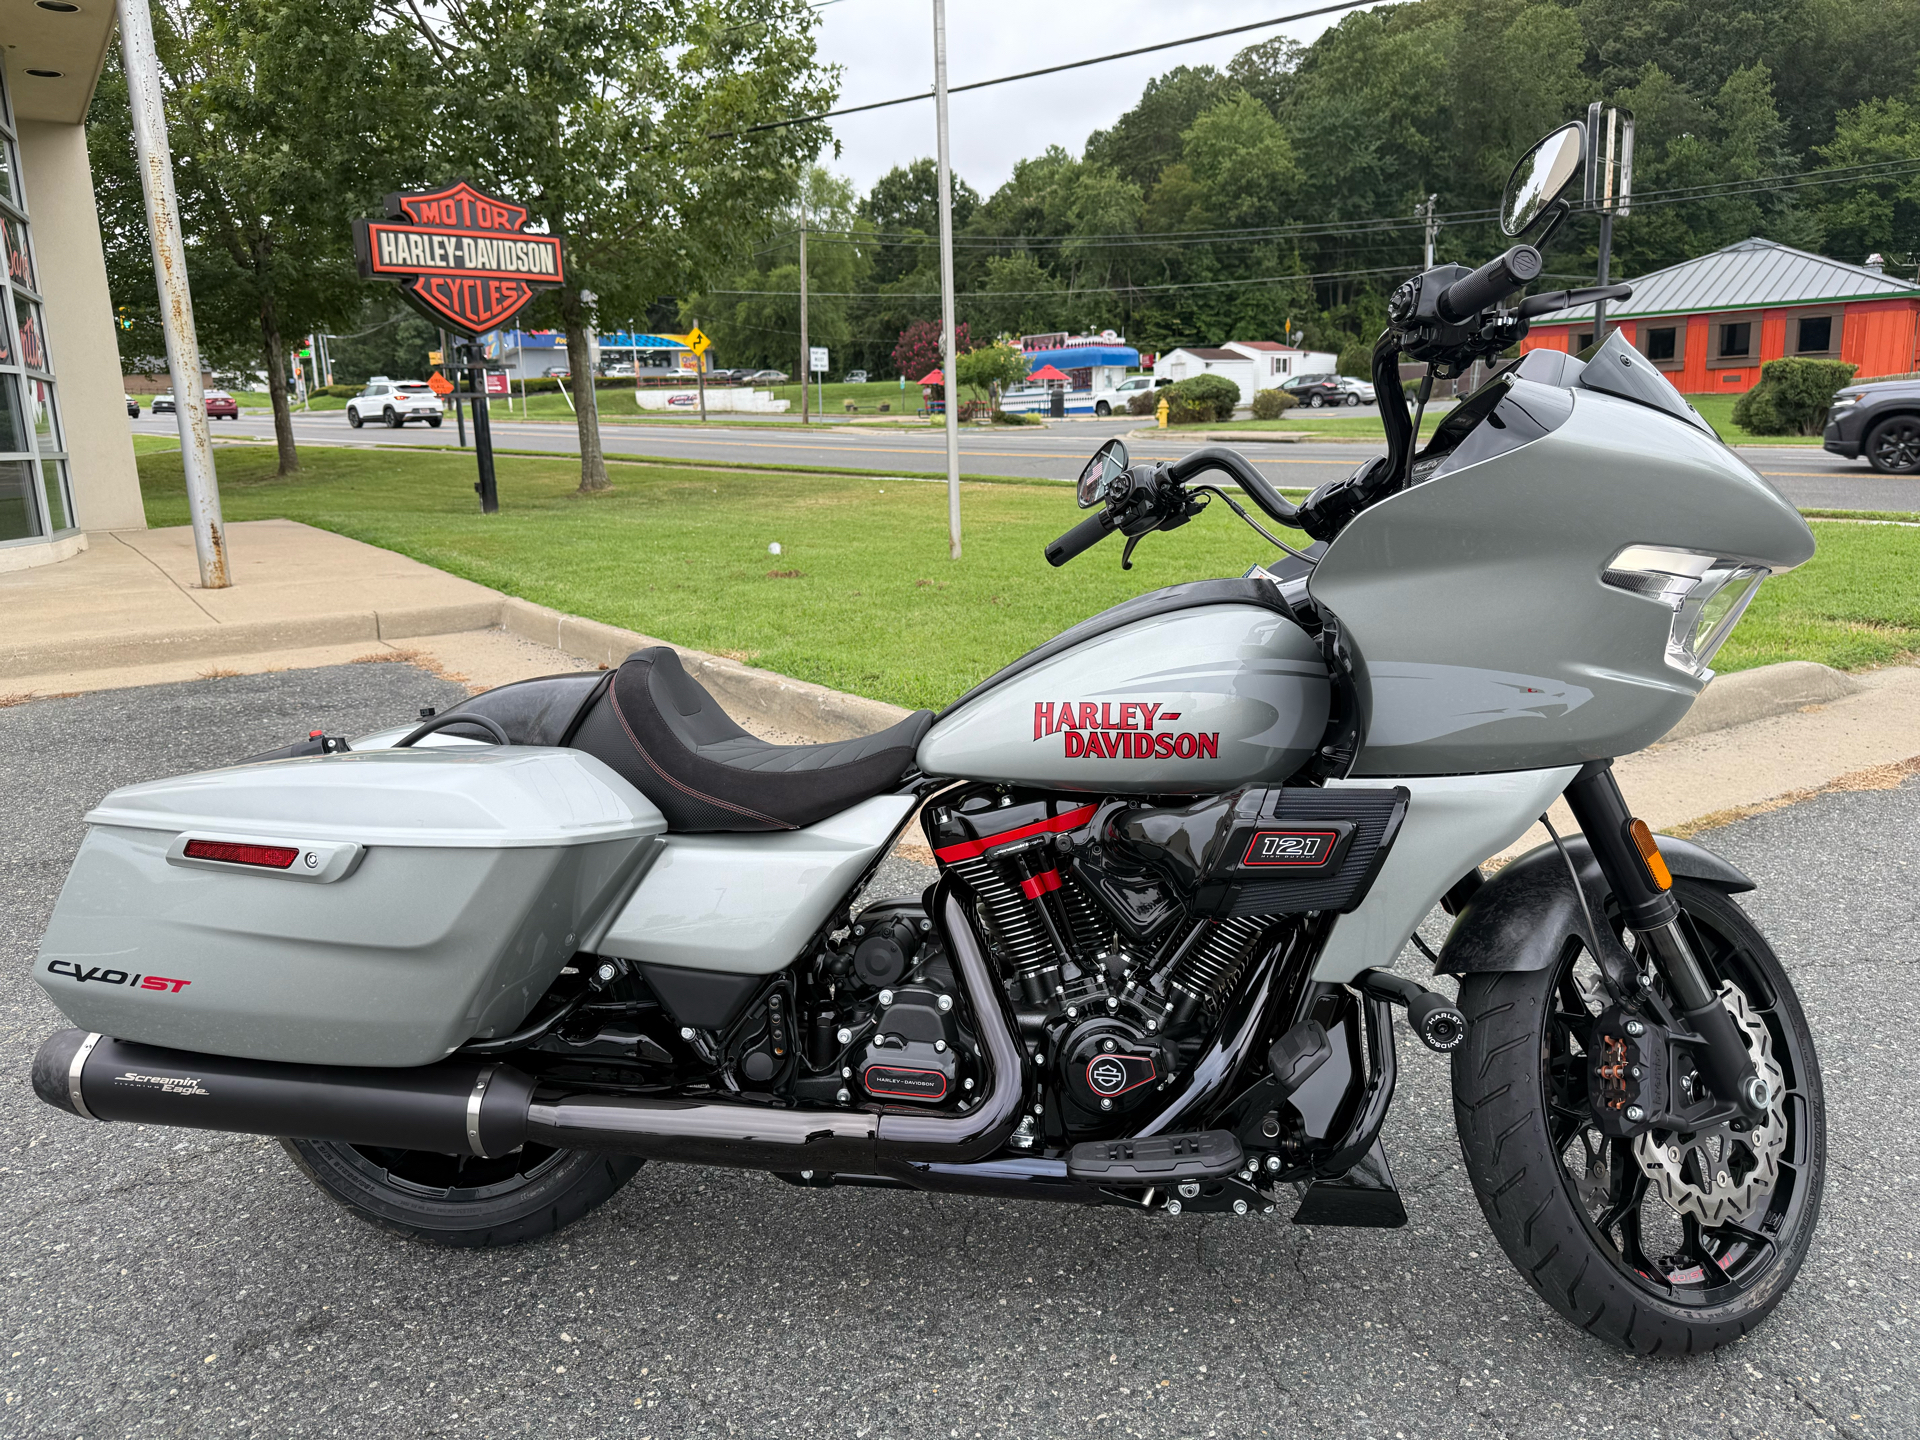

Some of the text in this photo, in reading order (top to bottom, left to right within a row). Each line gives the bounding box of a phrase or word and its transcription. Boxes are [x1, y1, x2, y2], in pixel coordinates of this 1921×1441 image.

[420, 190, 512, 230] MOTOR
[380, 232, 554, 274] HARLEY-DAVIDSON
[430, 278, 517, 322] CYCLES
[1064, 731, 1220, 759] DAVIDSON
[1262, 838, 1320, 855] 121
[114, 1072, 202, 1086] Screamin'
[162, 1084, 210, 1095] Eagle
[876, 1078, 934, 1086] HARLEY-DAVIDSON
